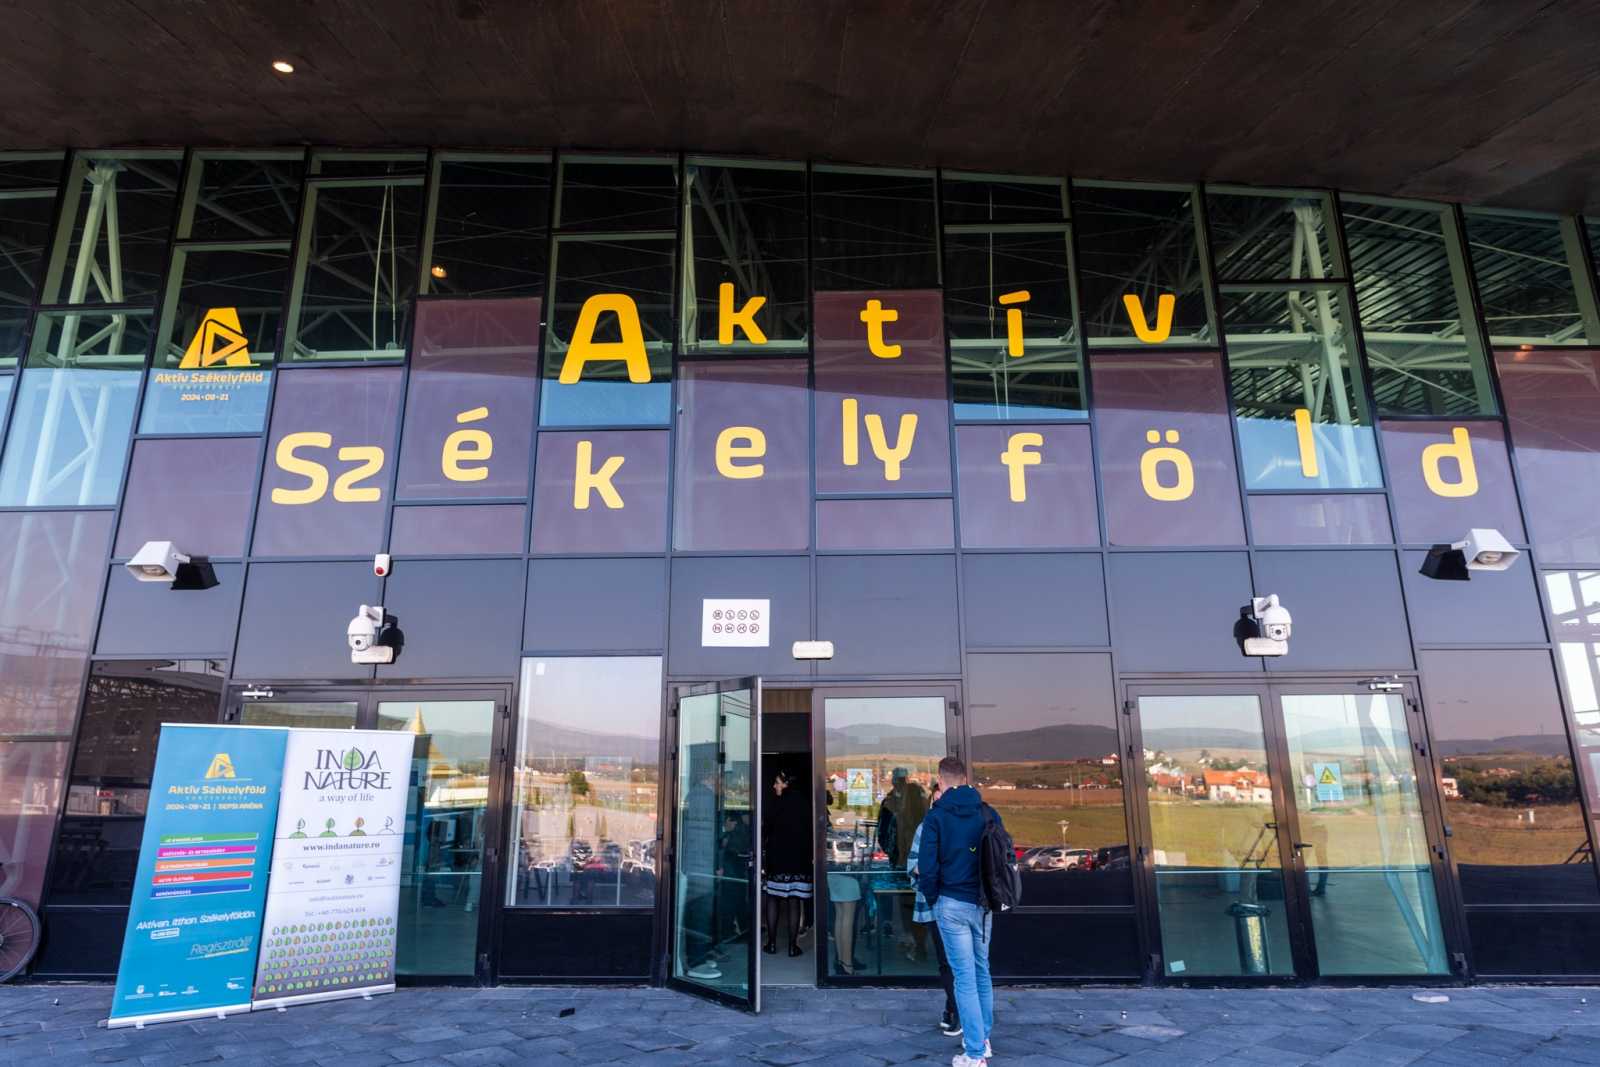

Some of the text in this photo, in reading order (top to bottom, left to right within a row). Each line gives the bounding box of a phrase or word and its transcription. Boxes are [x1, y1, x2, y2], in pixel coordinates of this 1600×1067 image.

[191, 370, 264, 384] Székelyföld
[315, 746, 382, 771] INDA
[303, 771, 392, 790] NATURE
[201, 784, 267, 796] Székelyföld
[327, 794, 347, 804] way
[347, 792, 359, 802] of
[360, 792, 375, 802] life
